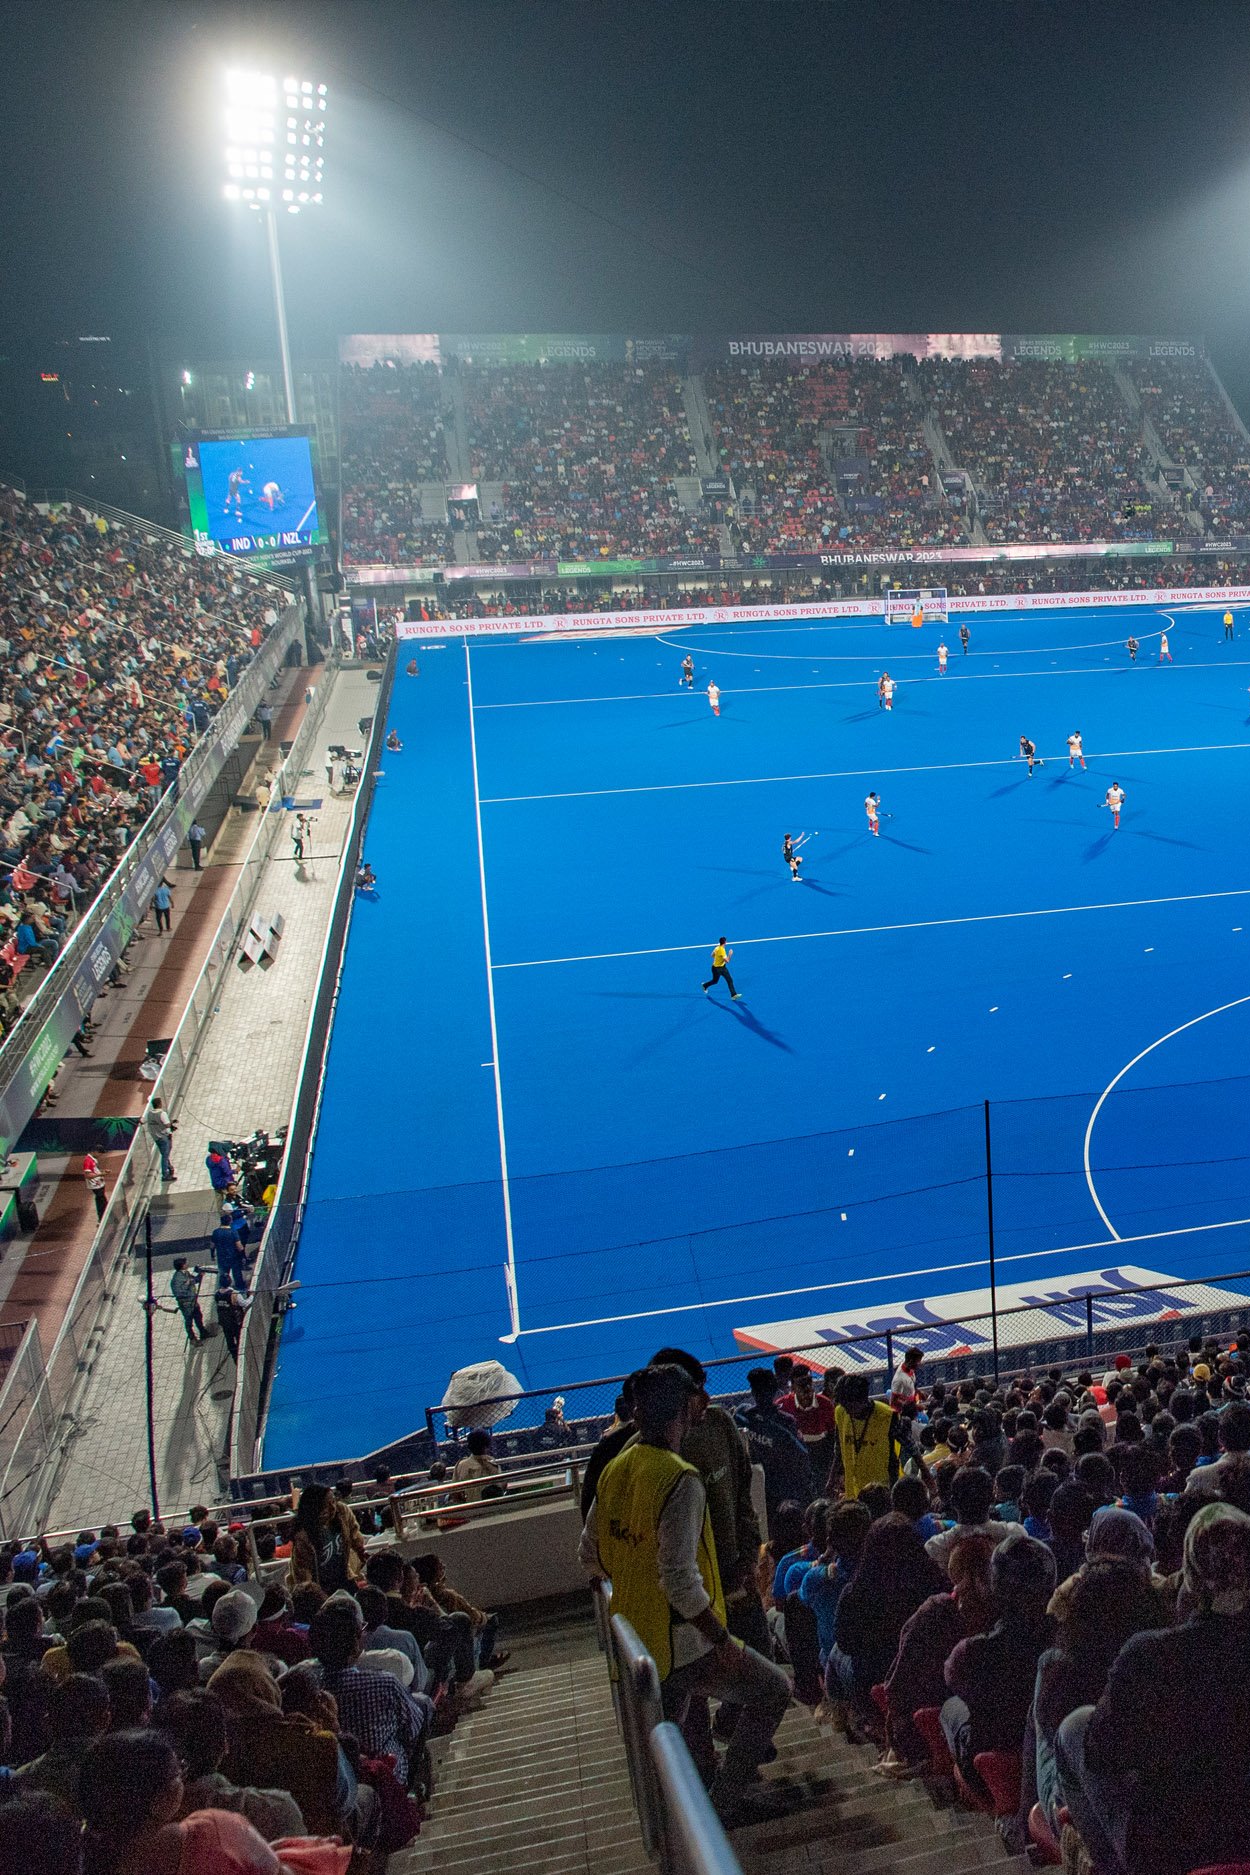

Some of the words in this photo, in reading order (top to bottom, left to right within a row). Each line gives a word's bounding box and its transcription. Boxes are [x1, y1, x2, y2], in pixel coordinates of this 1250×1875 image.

[540, 347, 595, 356] LEGENDS
[729, 342, 854, 355] BHUBANESWAR
[858, 342, 892, 354] 2023
[1014, 346, 1061, 355] LEGENDS
[1149, 347, 1195, 356] LEGENDS
[232, 537, 250, 550] IND
[283, 533, 301, 544] NZL
[821, 554, 913, 565] BHUBANESWAR
[916, 552, 942, 561] 2023
[1031, 597, 1066, 605] RUNGTA
[1069, 596, 1090, 604] SONS
[1092, 595, 1128, 603] PRIVATE
[1205, 591, 1226, 599] SONS
[950, 600, 987, 608] PRIVATE
[733, 609, 770, 618] RUNGTA
[800, 606, 840, 615] PRIVATE
[573, 618, 611, 627] RUNGTA
[615, 615, 640, 623] SONS
[643, 614, 684, 622] PRIVATE
[405, 625, 446, 634] RUNGTA
[450, 624, 475, 632] SONS
[479, 622, 521, 631] PRIVATE
[524, 620, 546, 628] LTD.
[745, 1431, 772, 1448] OLICE
